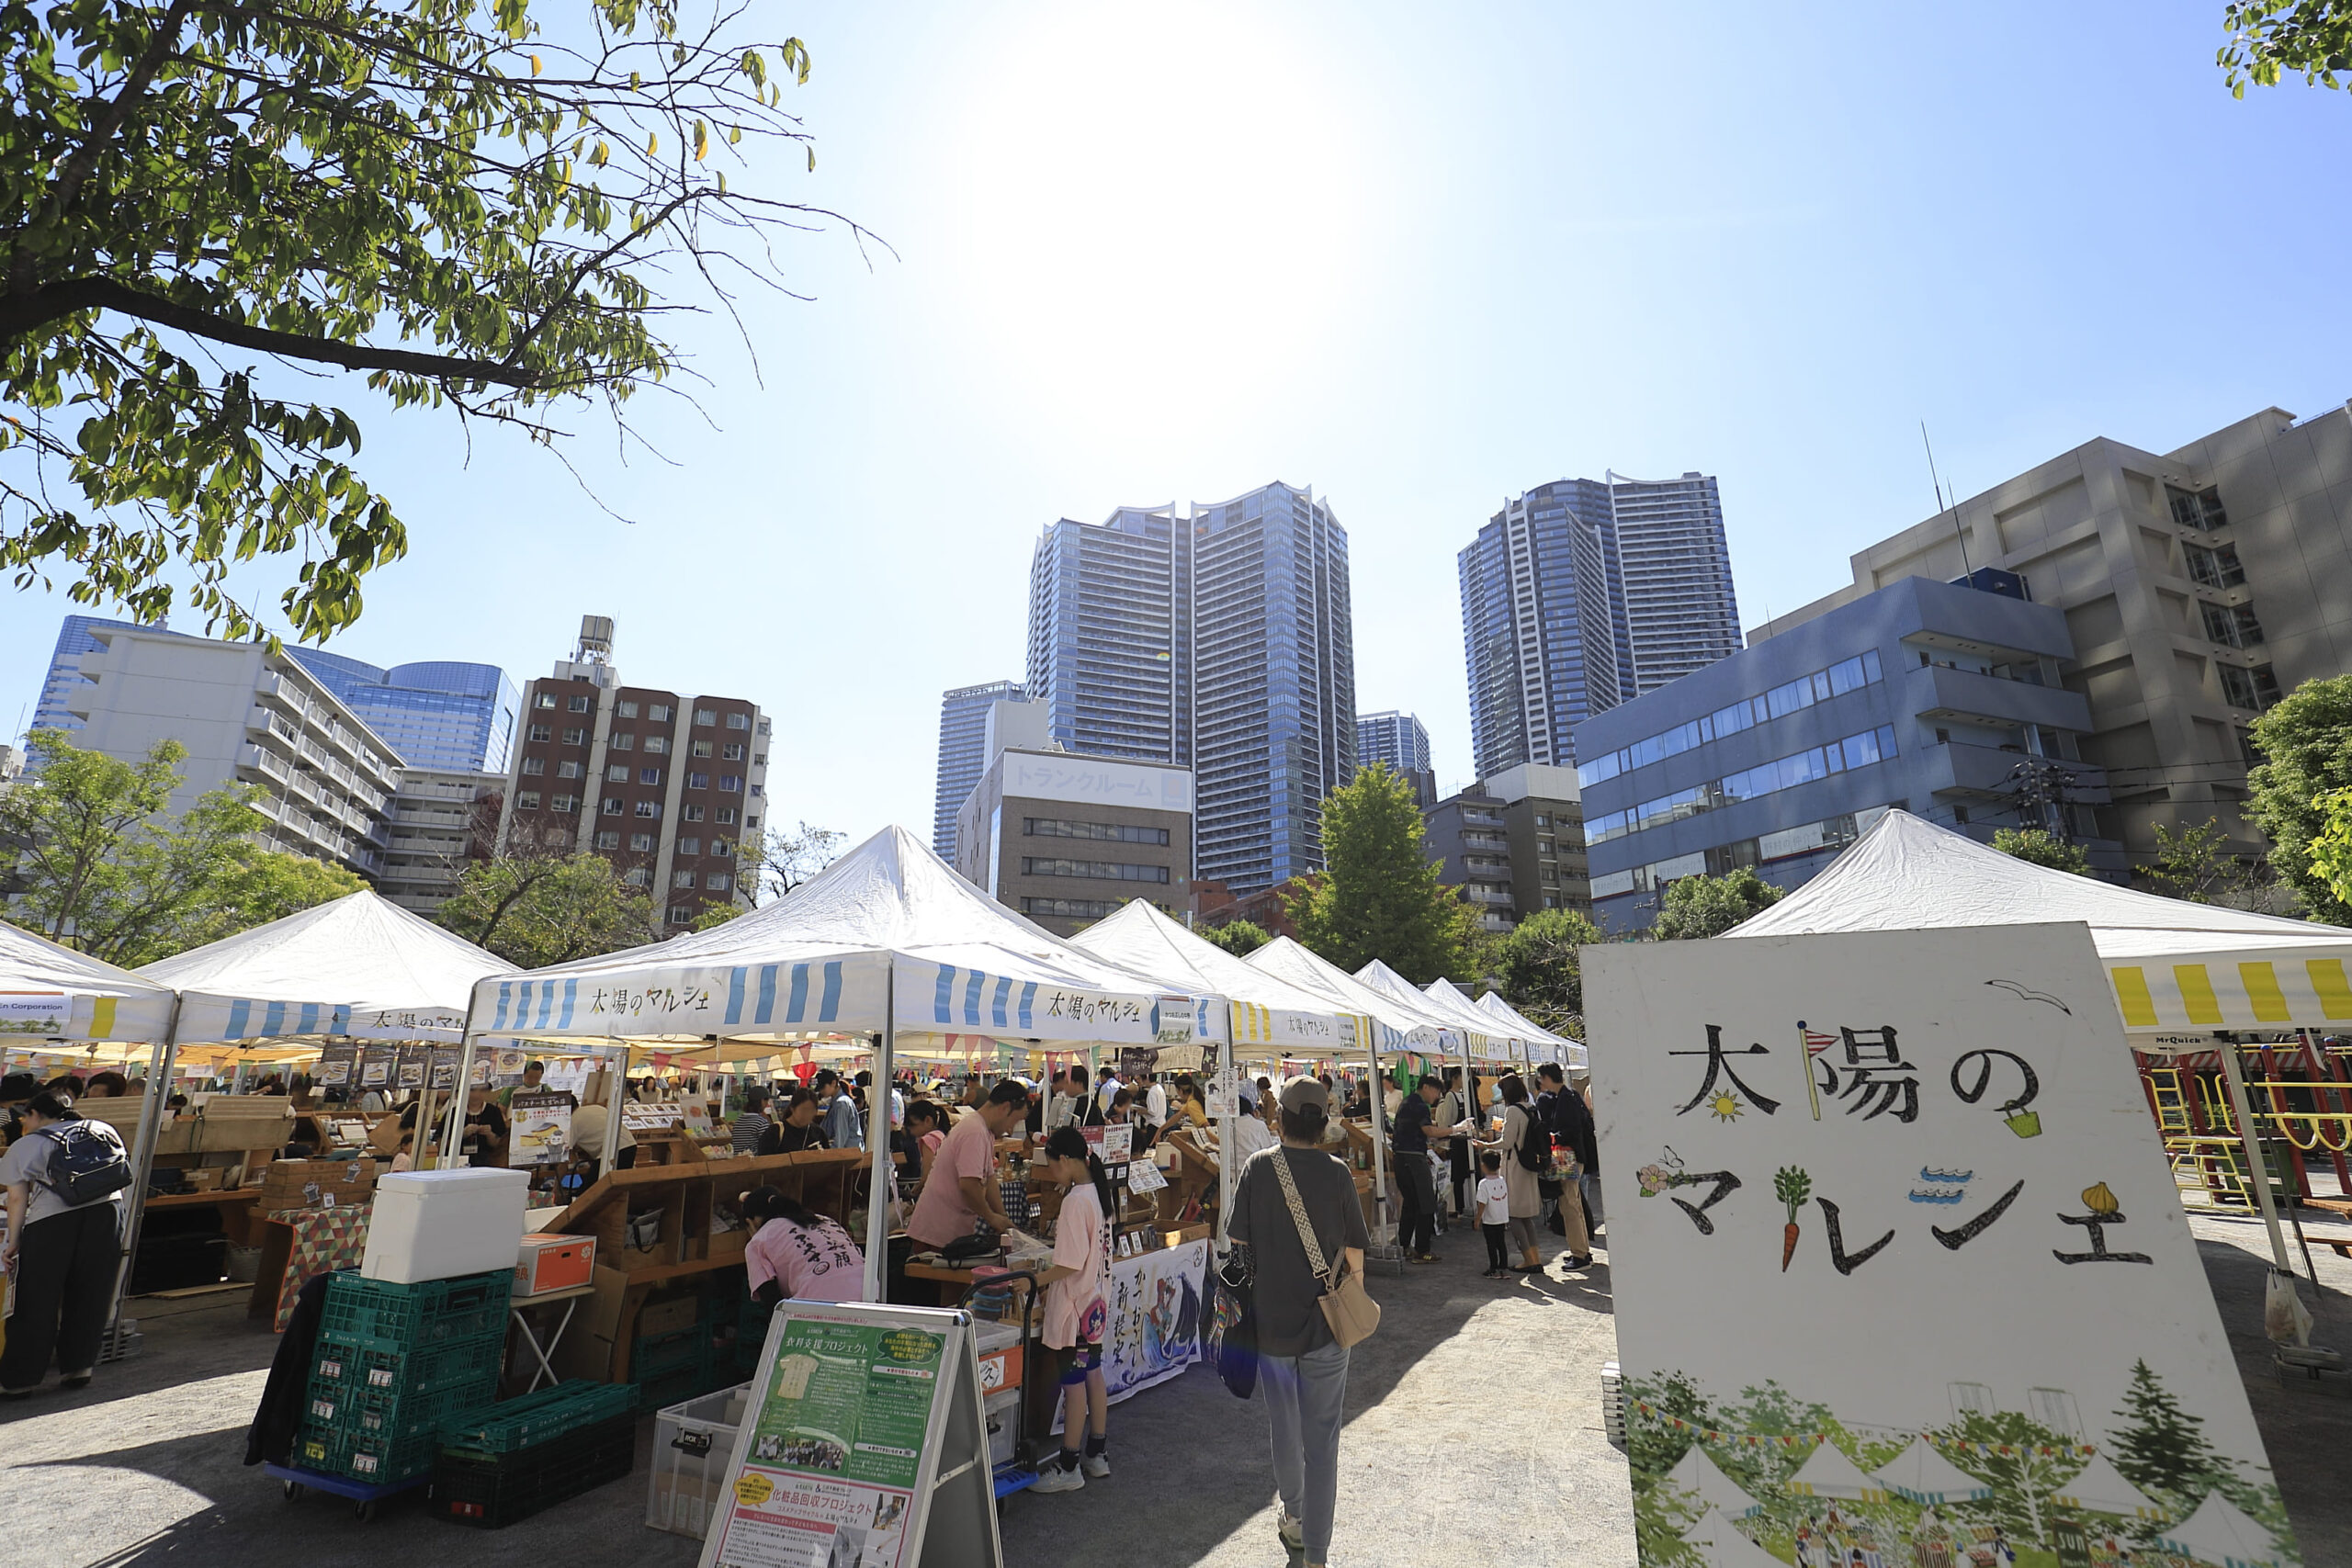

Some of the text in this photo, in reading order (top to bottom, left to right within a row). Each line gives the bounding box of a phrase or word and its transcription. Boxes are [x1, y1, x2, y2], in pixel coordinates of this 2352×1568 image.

[1017, 765, 1153, 798] トランクルーム
[591, 986, 709, 1016] 太陽のマルシェ
[1047, 991, 1140, 1023] 太陽のマルシェ
[1287, 1016, 1329, 1036] 太陽のマルシェ
[1668, 1021, 2041, 1137] 太陽の
[1636, 1163, 2154, 1276] マルシェ
[786, 1337, 868, 1355] 衣料支援プロジェクト
[773, 1488, 872, 1516] 化粧品回収プロジェクト
